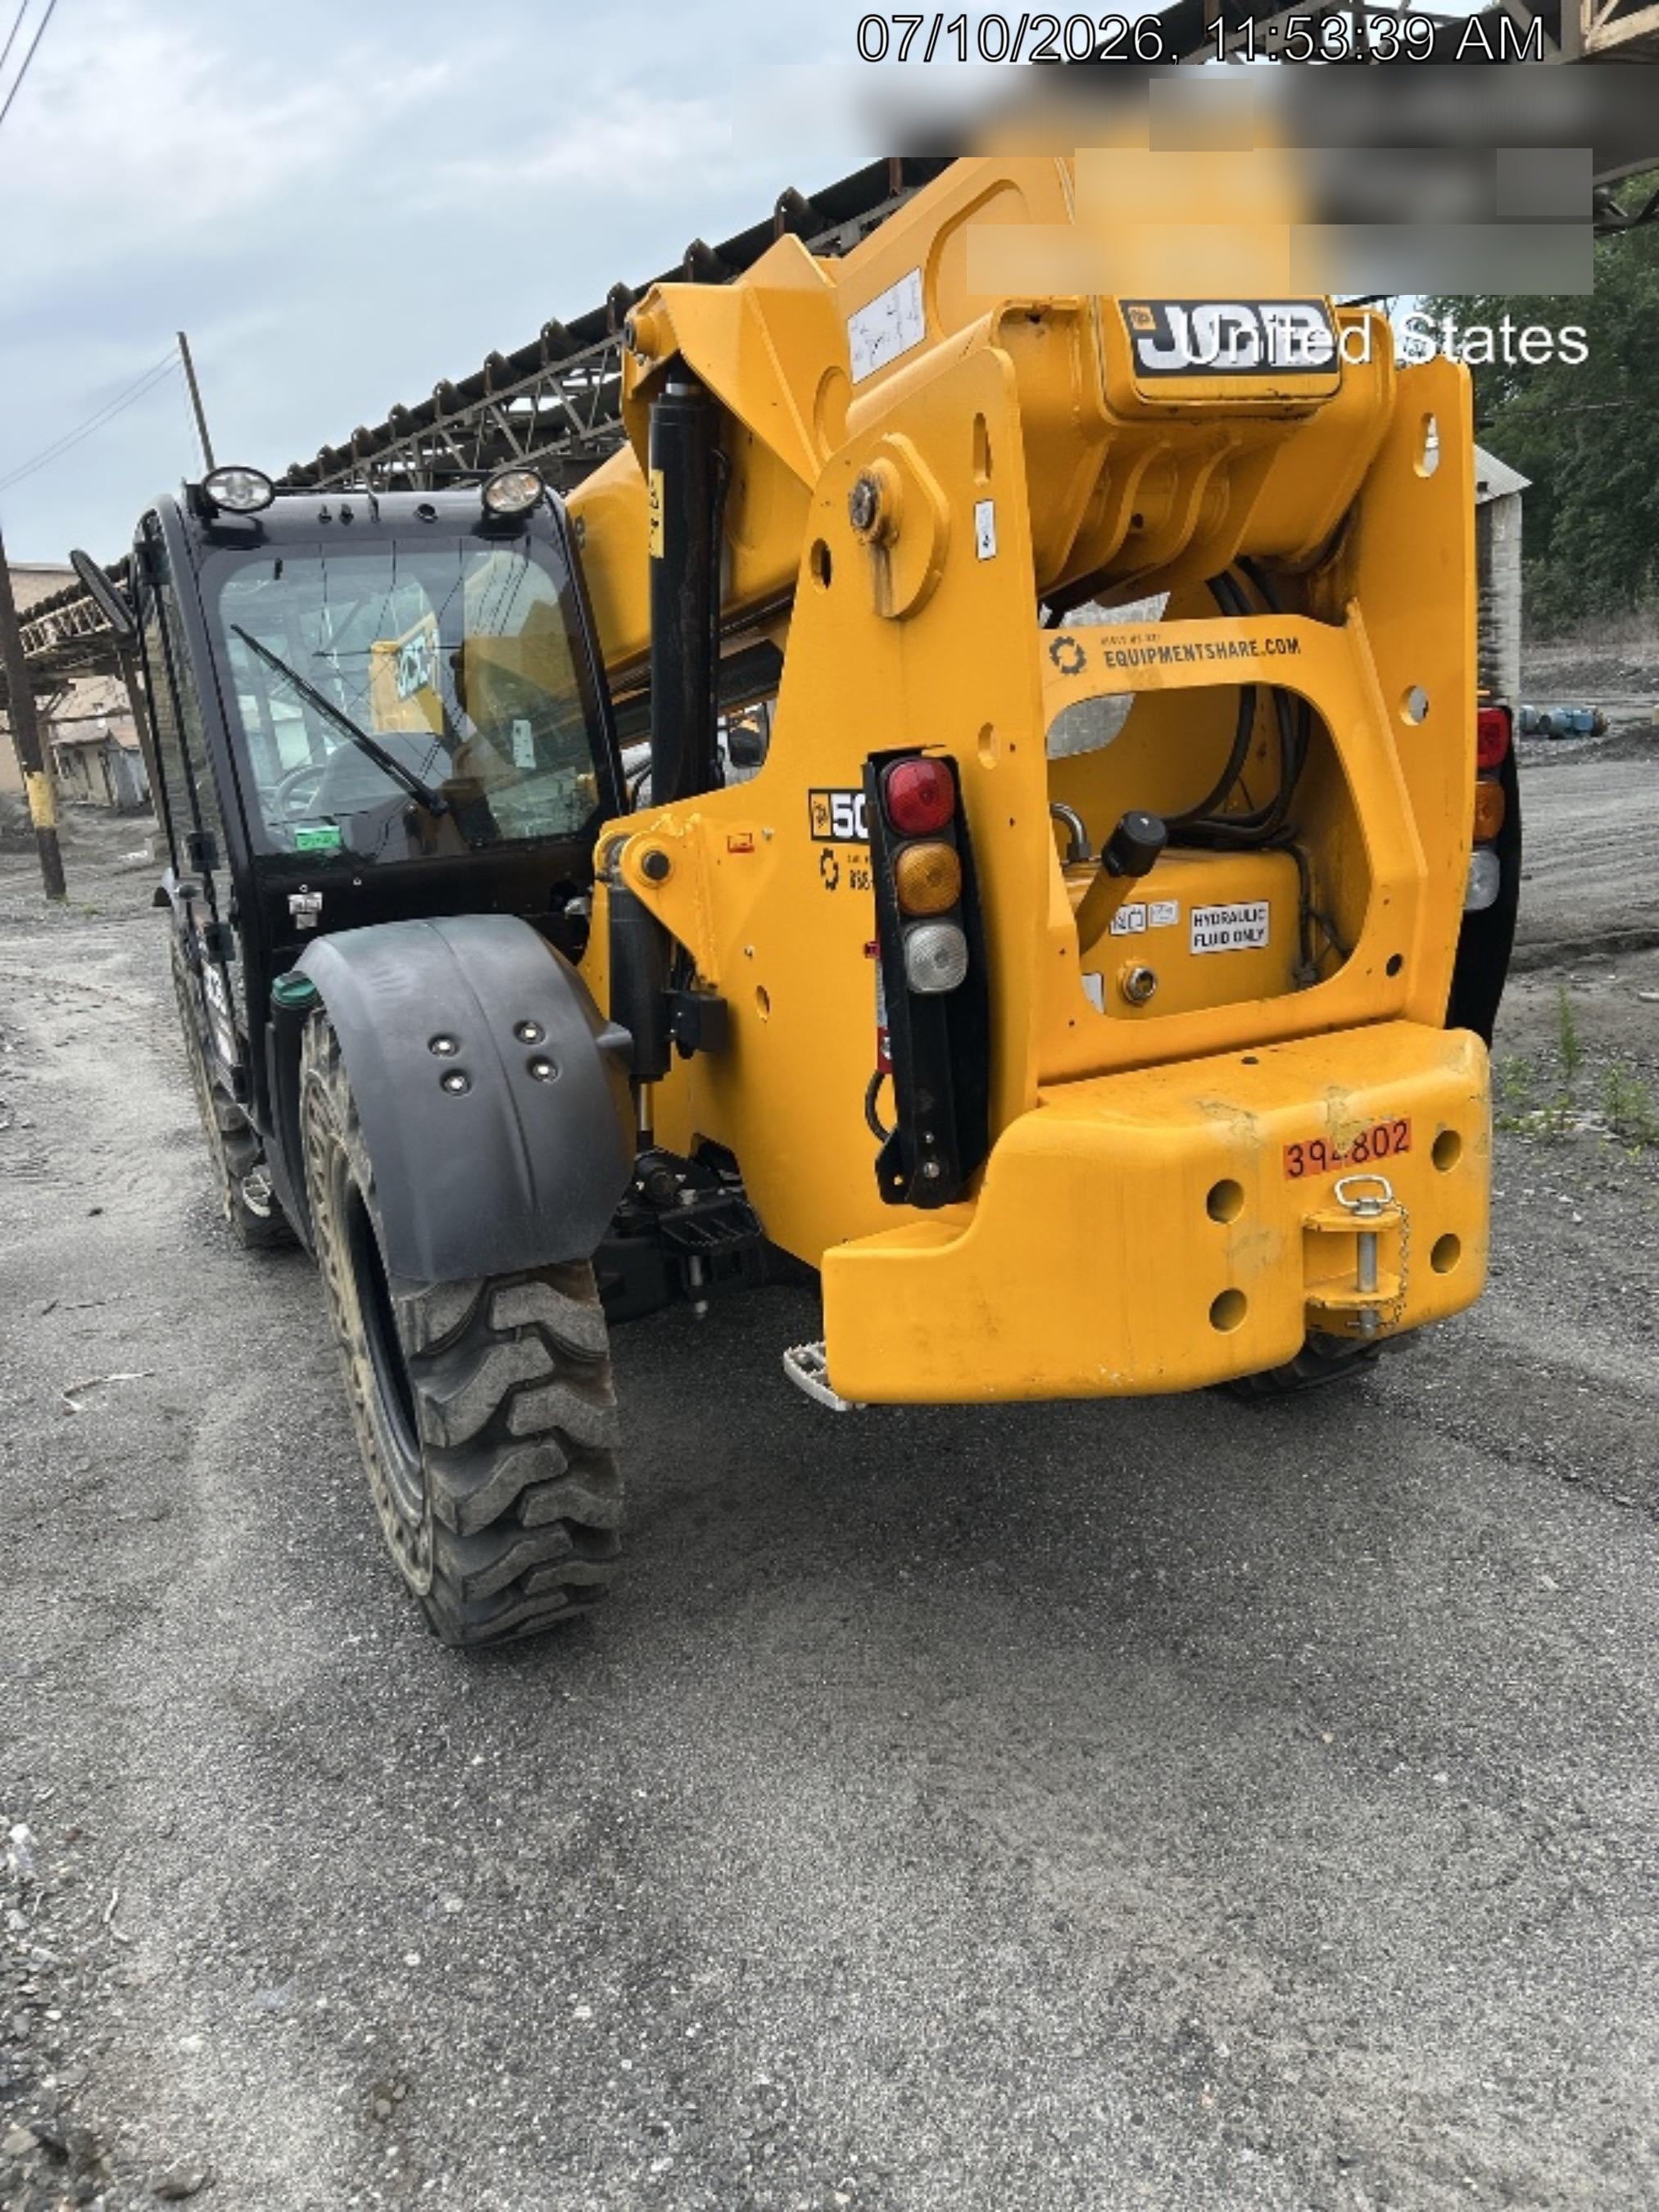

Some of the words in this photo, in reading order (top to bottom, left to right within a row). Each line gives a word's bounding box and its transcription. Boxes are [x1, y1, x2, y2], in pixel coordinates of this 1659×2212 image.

[1104, 637, 1301, 669] EQUIPMENTSHARE.COM
[1194, 908, 1267, 927] HYDRAULIC
[1194, 931, 1230, 947] FLUID
[1233, 928, 1264, 943] ONLY
